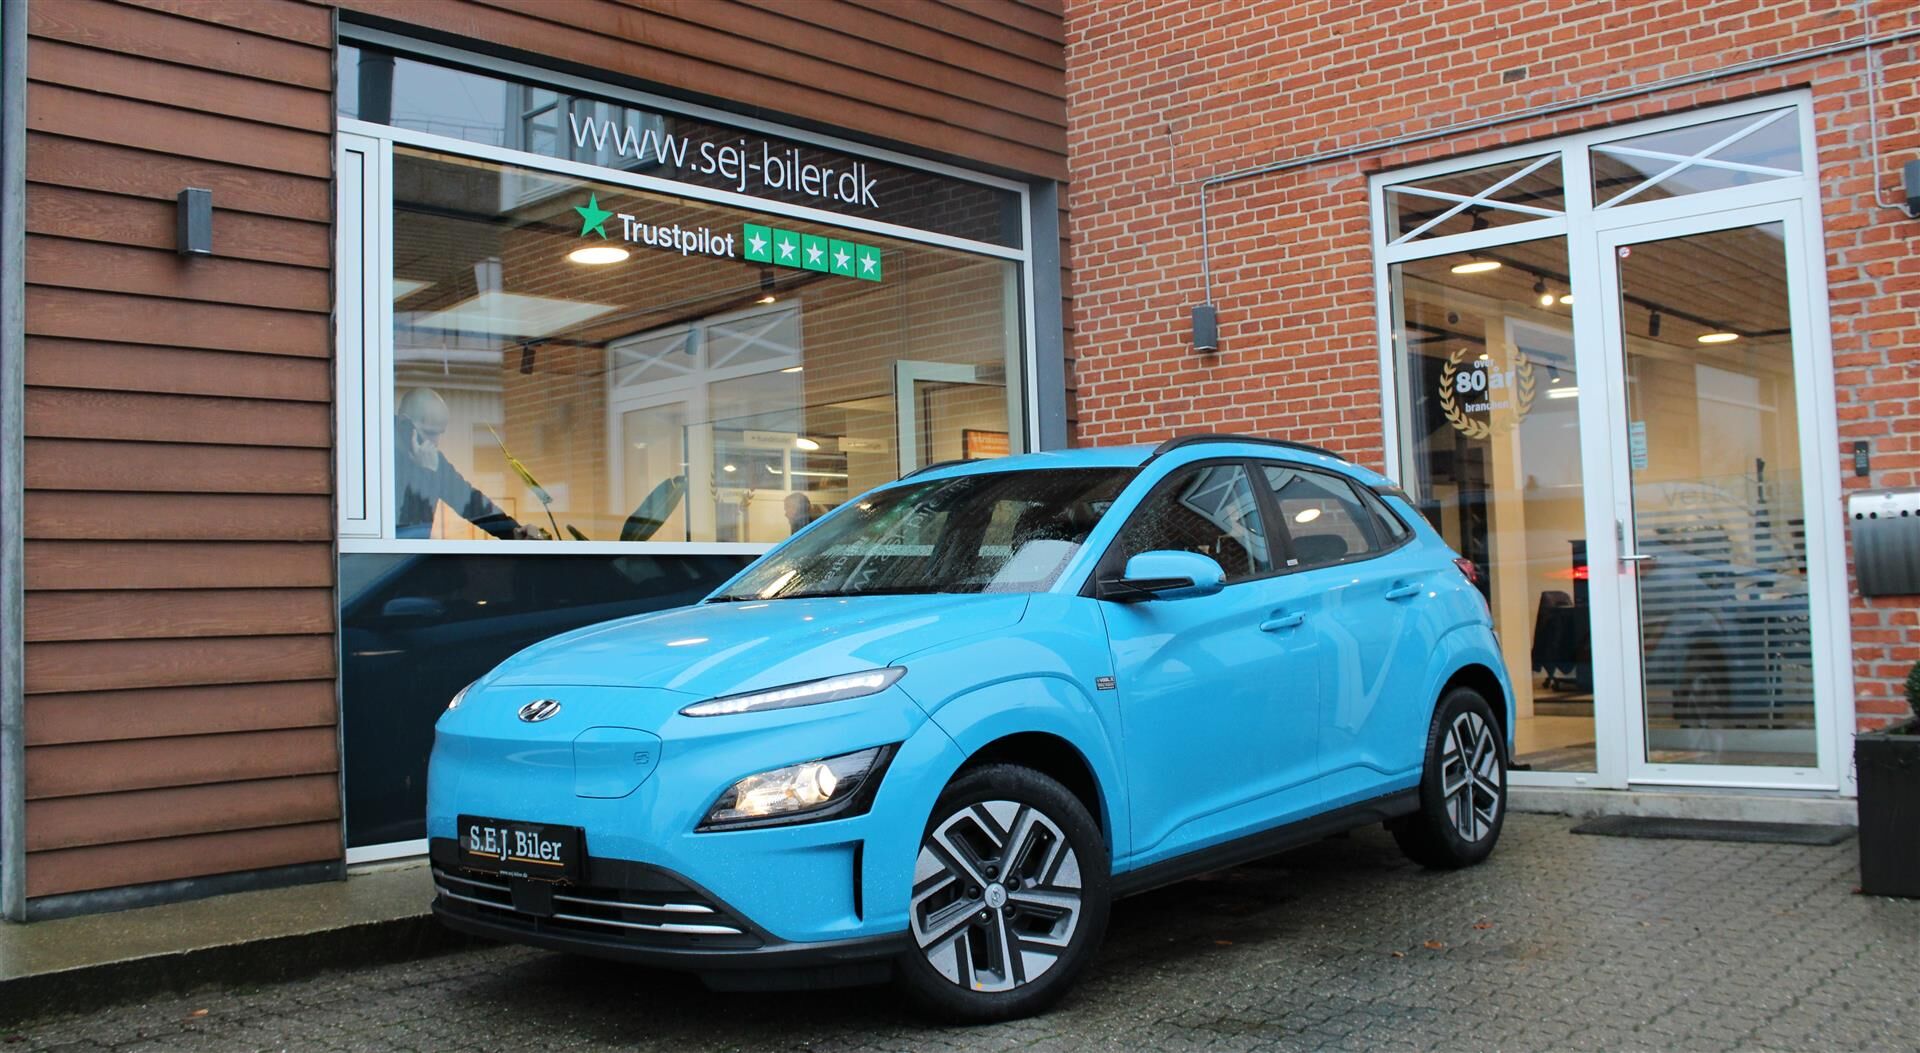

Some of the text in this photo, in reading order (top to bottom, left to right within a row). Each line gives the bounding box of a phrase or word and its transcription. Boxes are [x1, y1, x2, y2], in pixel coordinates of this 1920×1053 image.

[569, 112, 880, 209] www.sej-biler.dk
[617, 213, 735, 258] Trustpilot
[1456, 367, 1515, 393] 80 år
[1474, 360, 1494, 368] over
[470, 825, 562, 861] S.E.J. Biler
